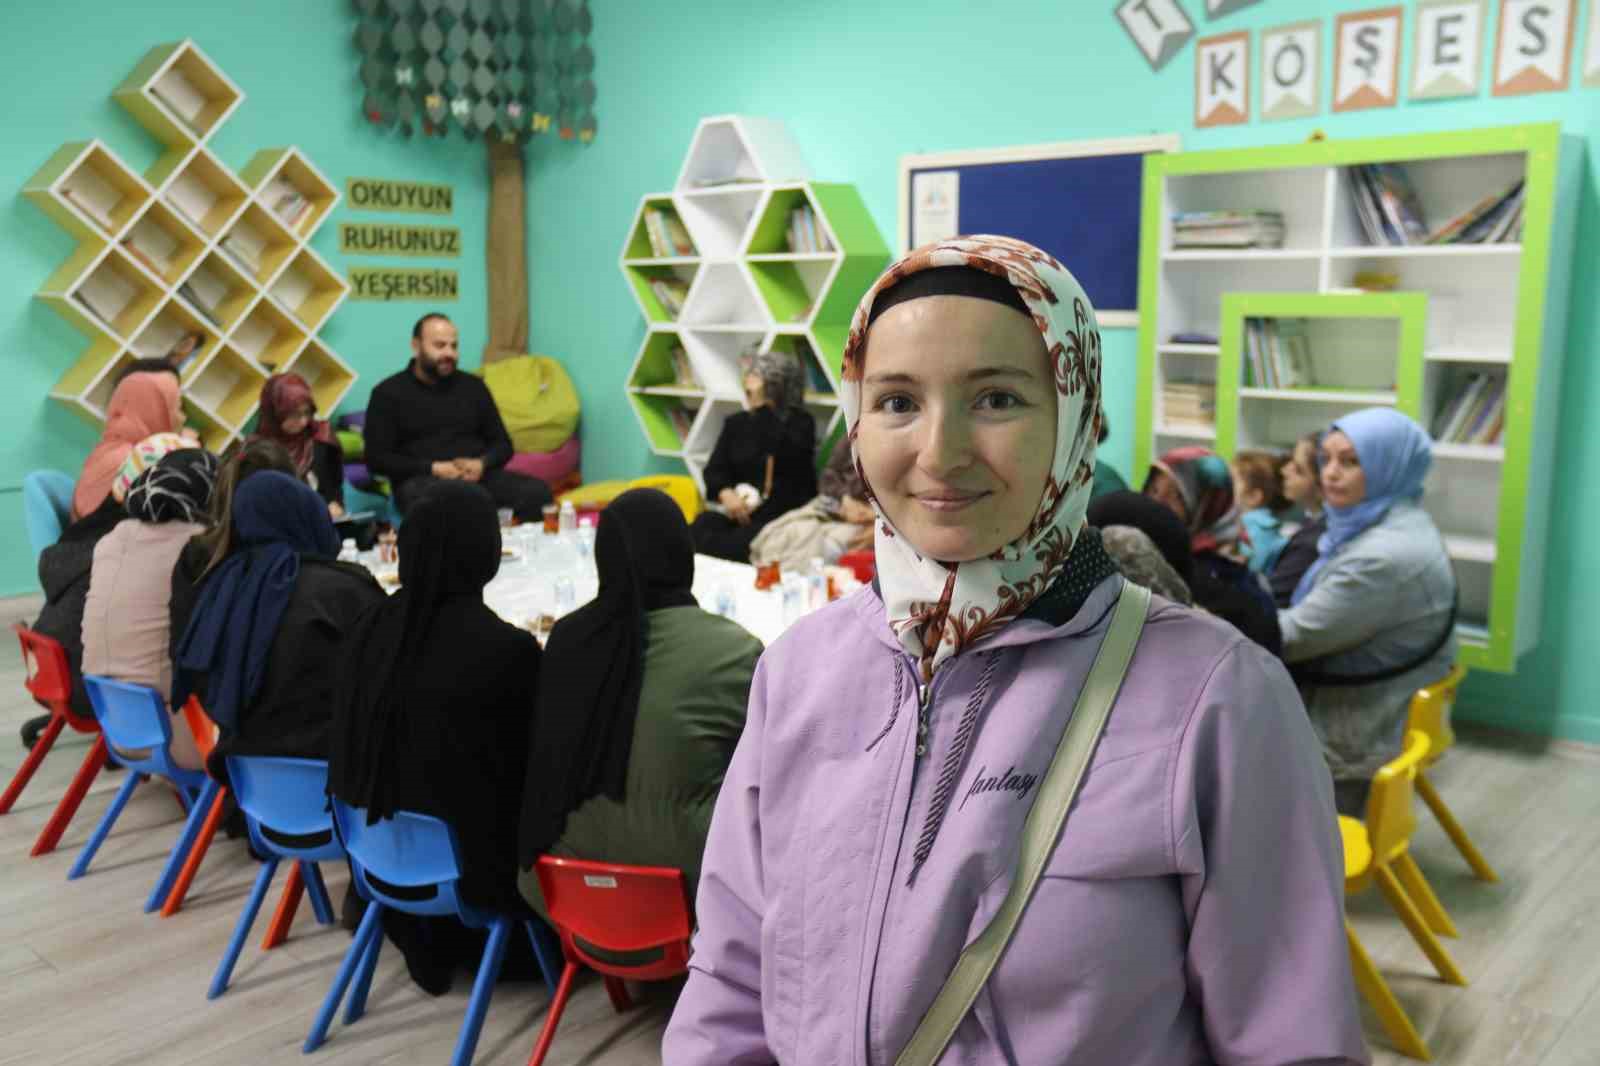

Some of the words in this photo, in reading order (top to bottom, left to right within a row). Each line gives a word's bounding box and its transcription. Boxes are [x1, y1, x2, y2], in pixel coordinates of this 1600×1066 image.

[350, 181, 453, 209] OKUYUN
[343, 226, 458, 253] RUHUNUZ
[351, 269, 458, 301] YEŞERSİN
[958, 765, 1039, 812] fantasy
